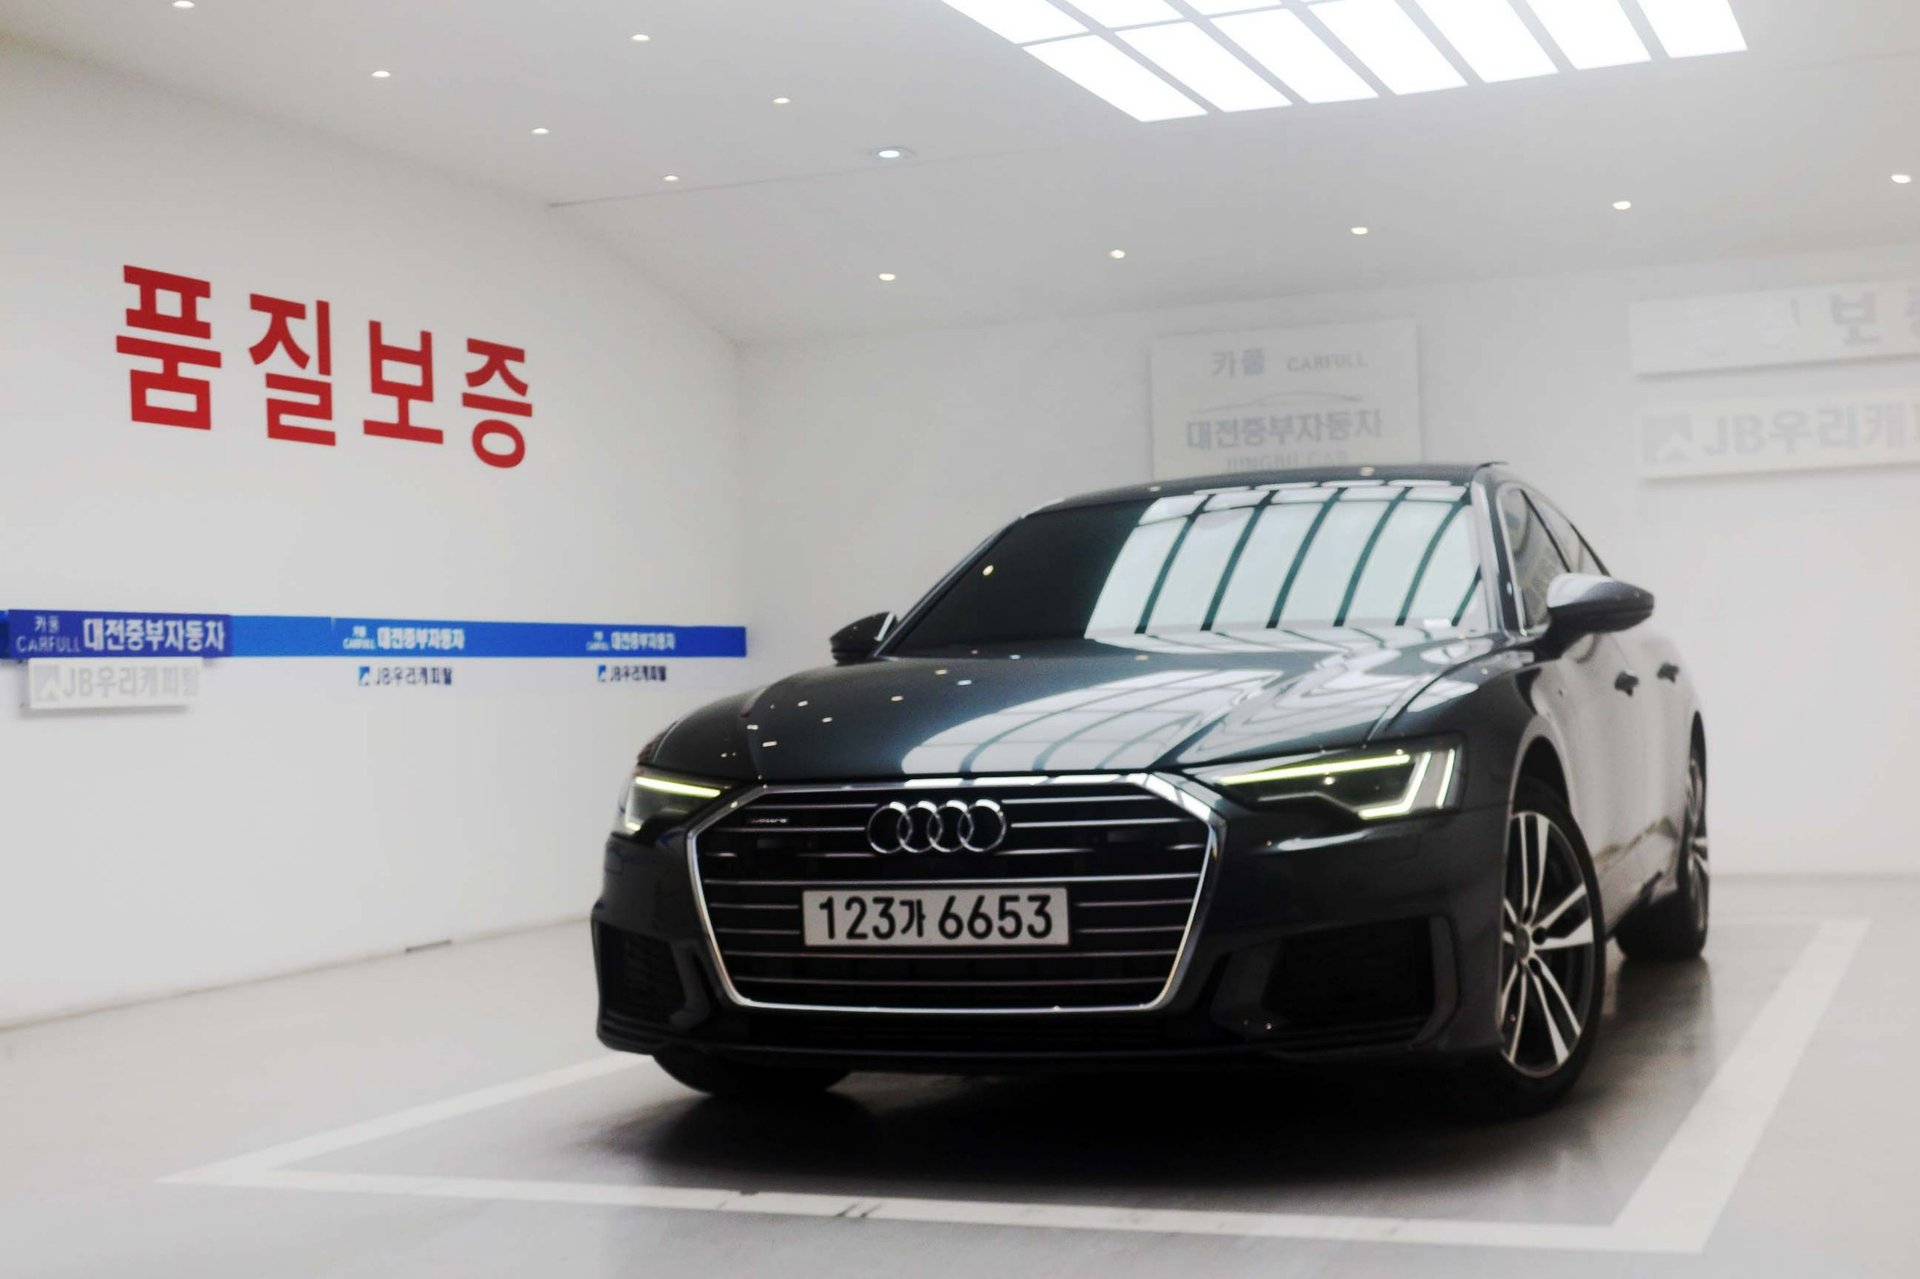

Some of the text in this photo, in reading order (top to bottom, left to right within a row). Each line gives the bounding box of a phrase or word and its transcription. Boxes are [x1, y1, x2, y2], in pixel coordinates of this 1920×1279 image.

[116, 264, 533, 469] 품질보증
[1702, 402, 1920, 458] JB우리캐
[83, 617, 225, 652] 대전중부자동차
[818, 894, 1053, 940] 123가 6653
